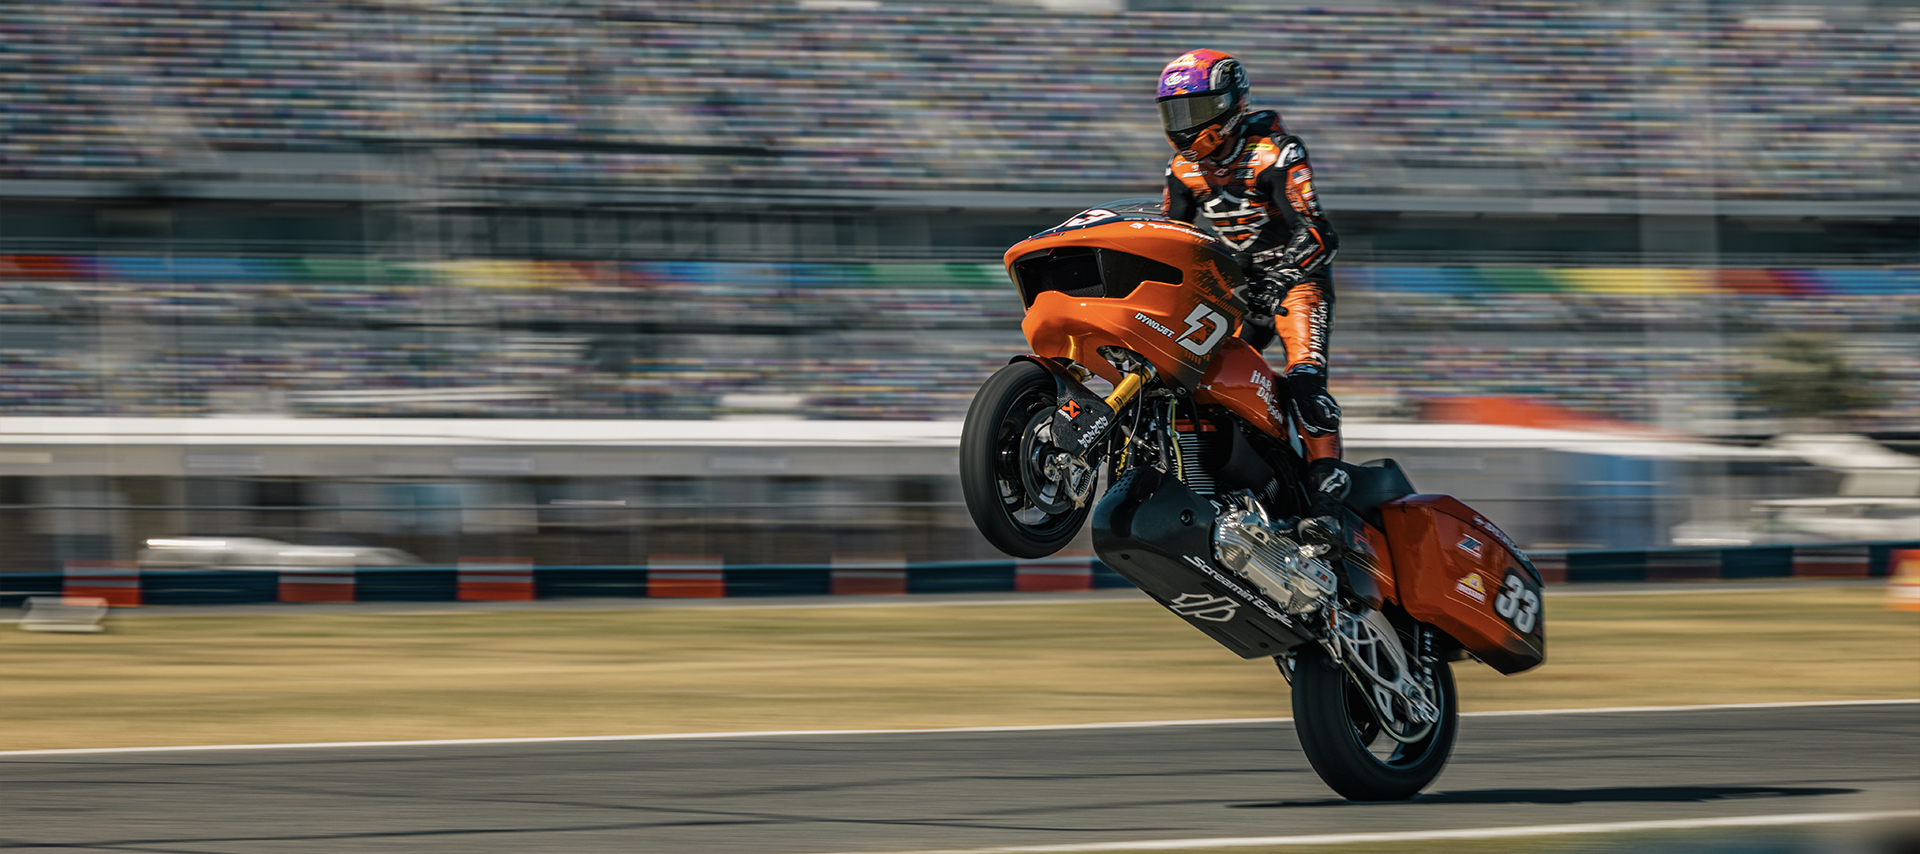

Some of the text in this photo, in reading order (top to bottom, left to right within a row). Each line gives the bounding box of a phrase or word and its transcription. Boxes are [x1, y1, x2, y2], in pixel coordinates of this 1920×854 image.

[1134, 312, 1176, 339] DYNOJET
[1252, 598, 1294, 629] Eagle
[1494, 574, 1540, 634] 33
